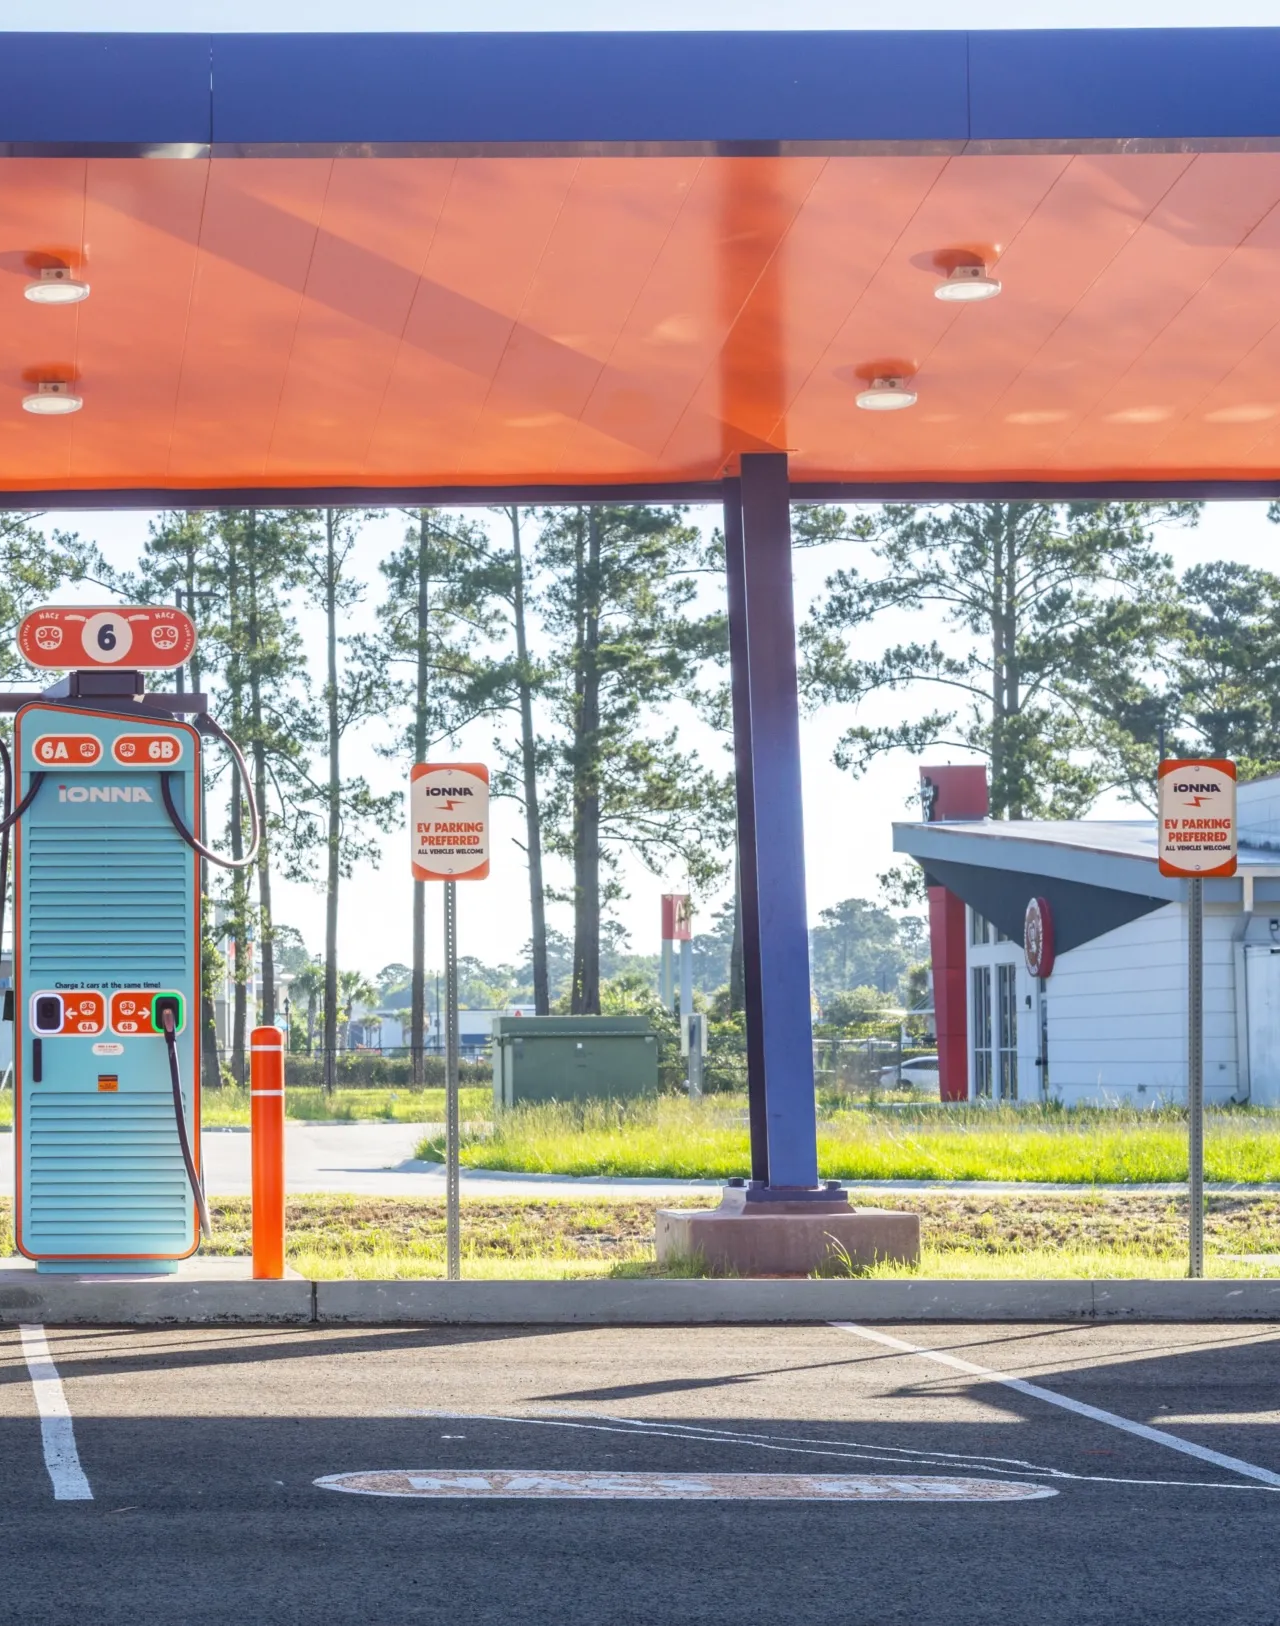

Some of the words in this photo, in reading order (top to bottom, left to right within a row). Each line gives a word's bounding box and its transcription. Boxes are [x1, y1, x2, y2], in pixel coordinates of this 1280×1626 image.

[39, 612, 59, 620] NACS
[154, 612, 175, 620] NACS
[97, 623, 116, 651] 6
[41, 741, 68, 759] 6A
[148, 741, 173, 759] 6B
[417, 822, 431, 833] EV
[434, 822, 484, 833] PARKING
[1164, 818, 1178, 830] EV
[1182, 818, 1231, 830] PARKING
[421, 835, 480, 846] PREFERRED
[1168, 831, 1227, 842] PREFERRED
[55, 982, 78, 990] Charge
[81, 1023, 93, 1031] 6A
[122, 1023, 133, 1031] 6B
[406, 1477, 713, 1492] NACS
